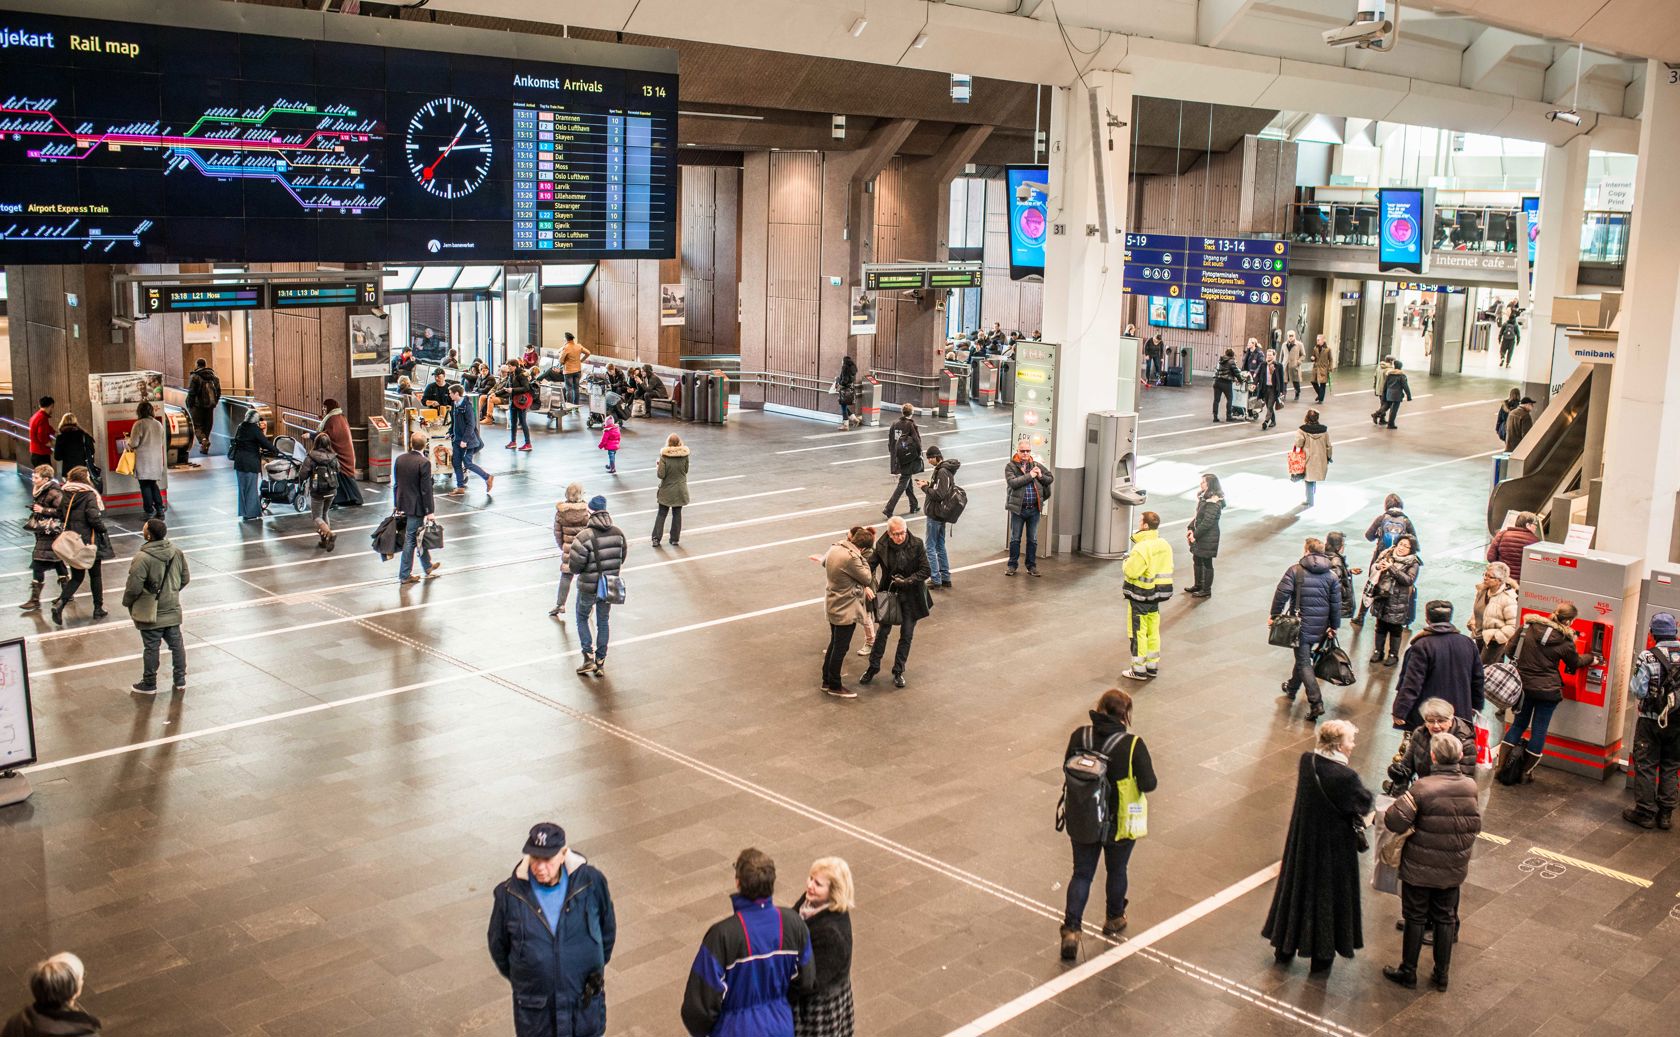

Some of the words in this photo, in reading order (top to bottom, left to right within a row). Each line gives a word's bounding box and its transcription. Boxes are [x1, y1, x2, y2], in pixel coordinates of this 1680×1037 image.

[70, 34, 101, 52] Rail
[105, 41, 140, 58] map
[1669, 70, 1680, 84] 3
[513, 74, 560, 90] Ankomst
[563, 78, 603, 93] Arrivals
[642, 86, 652, 97] 13
[654, 86, 666, 98] 14
[0, 204, 22, 214] toget
[28, 204, 56, 214] Airport
[57, 204, 88, 214] Express
[89, 205, 109, 213] Train
[1054, 224, 1064, 235] 31
[1219, 240, 1246, 252] 13-14
[1482, 257, 1504, 268] cafe
[364, 292, 375, 302] 10
[151, 299, 158, 309] 9
[1575, 350, 1615, 358] minibank
